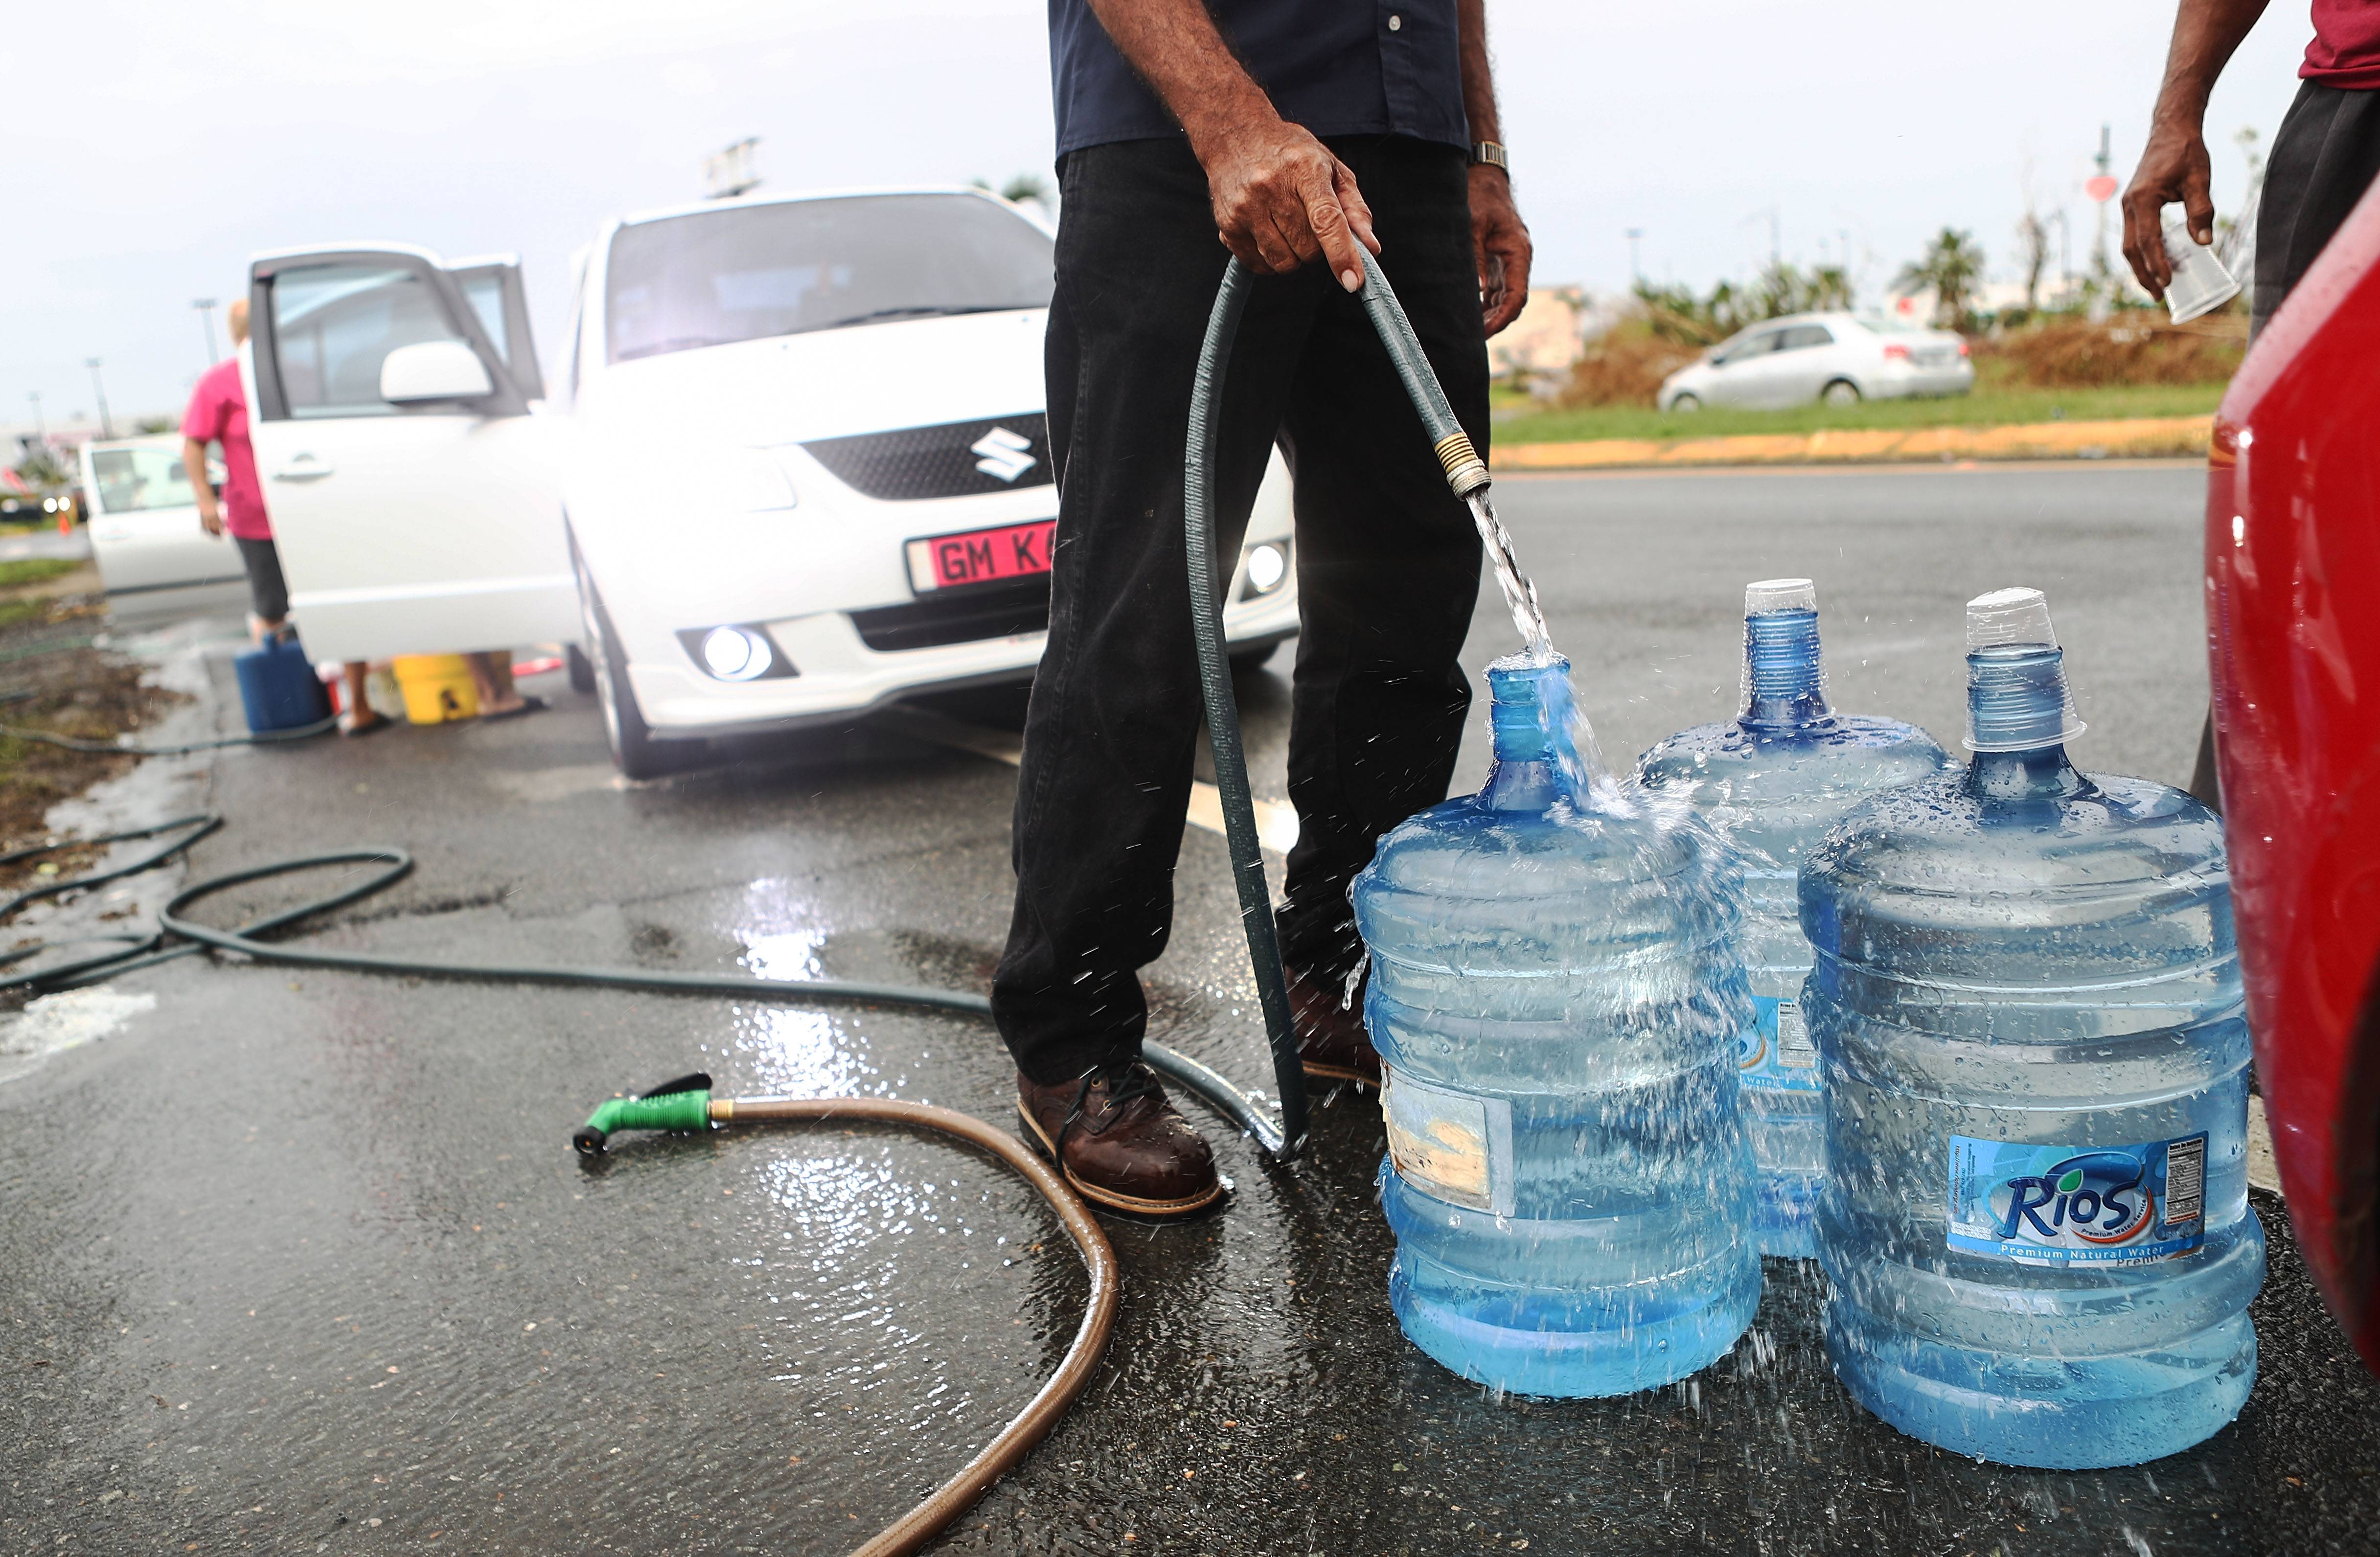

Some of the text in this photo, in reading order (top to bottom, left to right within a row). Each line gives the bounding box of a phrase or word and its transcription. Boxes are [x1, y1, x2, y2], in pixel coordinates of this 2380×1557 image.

[938, 537, 995, 580] GM
[2081, 1228, 2113, 1237] Premium
[2114, 1222, 2133, 1235] Water
[2001, 1244, 2163, 1259] Premium Natural Water
